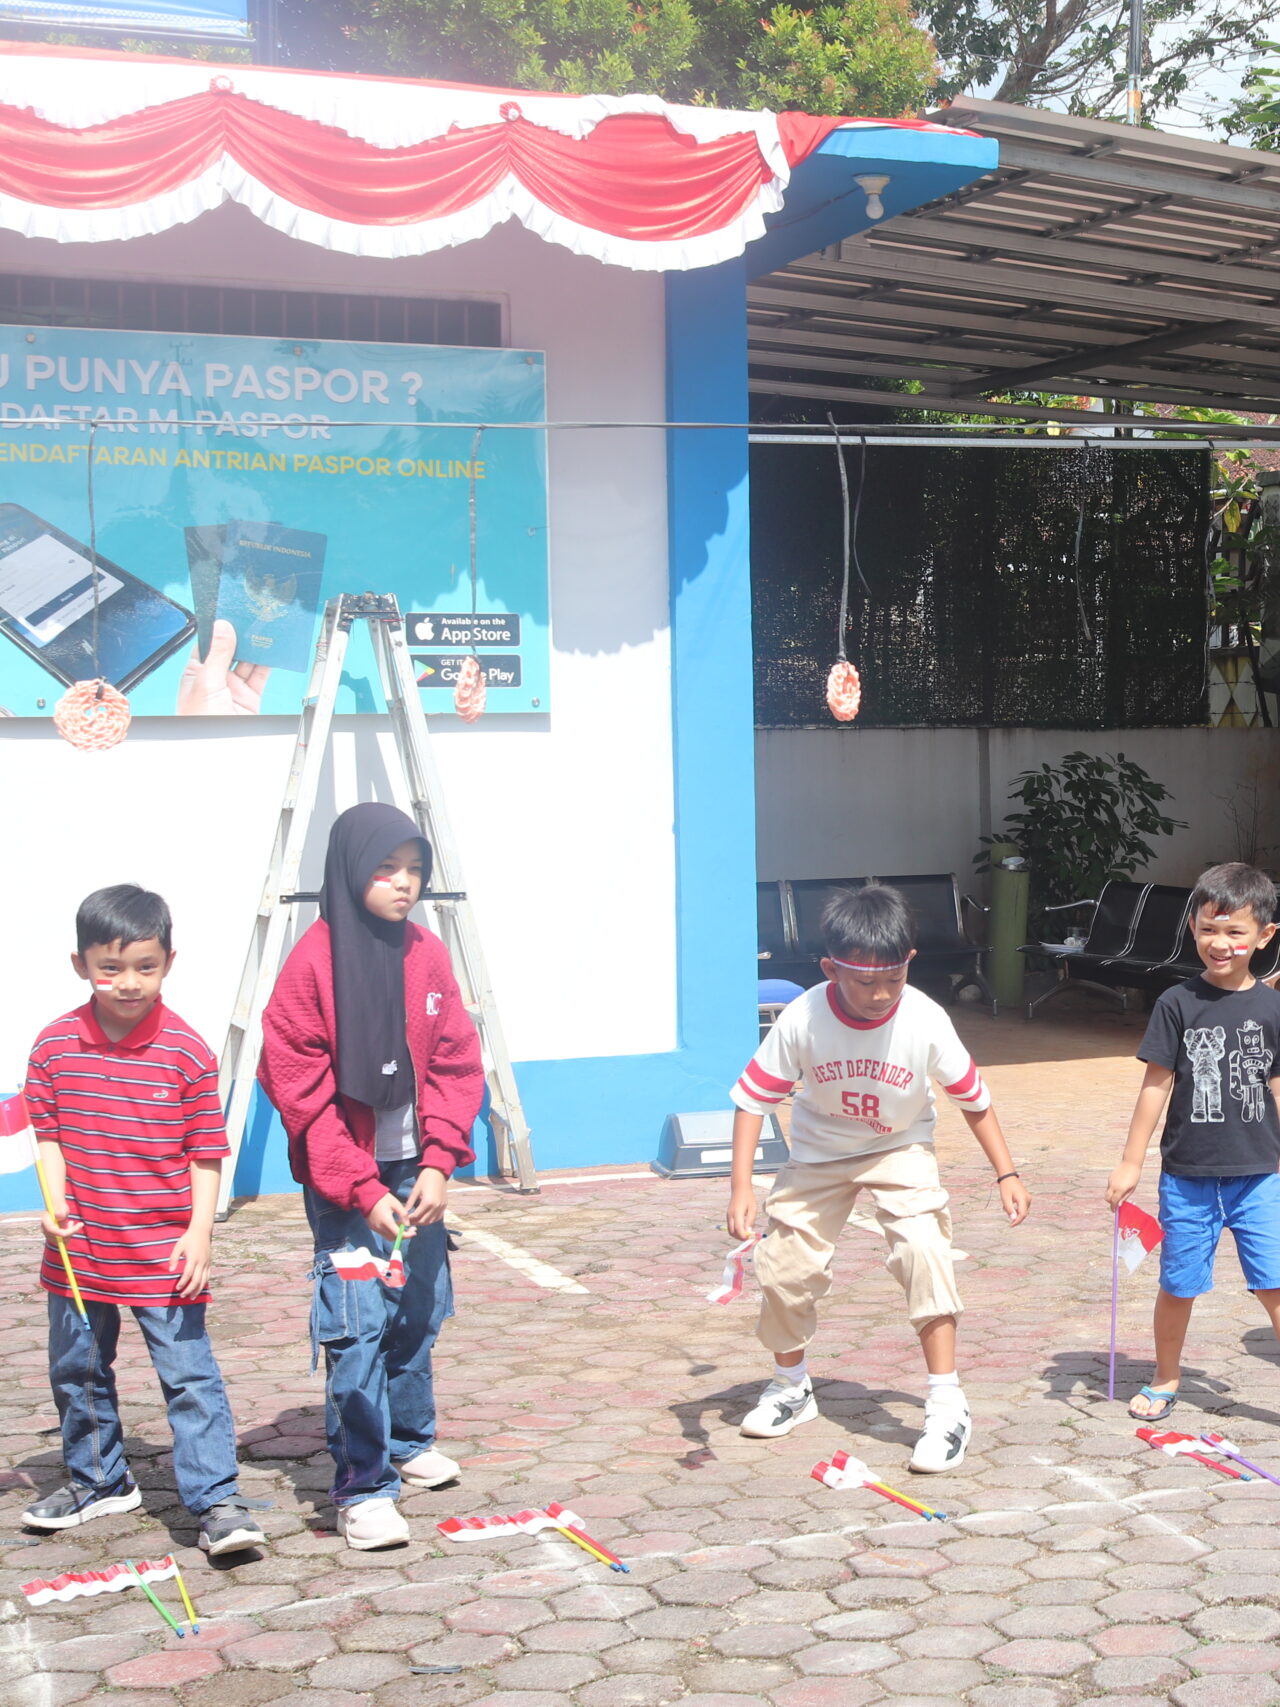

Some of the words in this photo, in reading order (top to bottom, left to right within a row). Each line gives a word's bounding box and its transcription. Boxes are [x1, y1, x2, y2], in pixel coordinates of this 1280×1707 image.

[26, 354, 193, 398] PUNYA
[205, 362, 390, 406] PASPOR
[400, 371, 423, 406] ?
[2, 402, 139, 434] DAFTAR
[175, 448, 287, 473] ANTRIAN
[293, 453, 392, 477] PASPOR
[397, 458, 487, 480] ONLINE
[441, 617, 478, 626] Availabe
[492, 617, 506, 626] the
[441, 627, 471, 644] App
[473, 627, 511, 641] Store
[489, 667, 515, 683] Play
[846, 1058, 914, 1090] DEFENDER
[841, 1090, 880, 1118] 58
